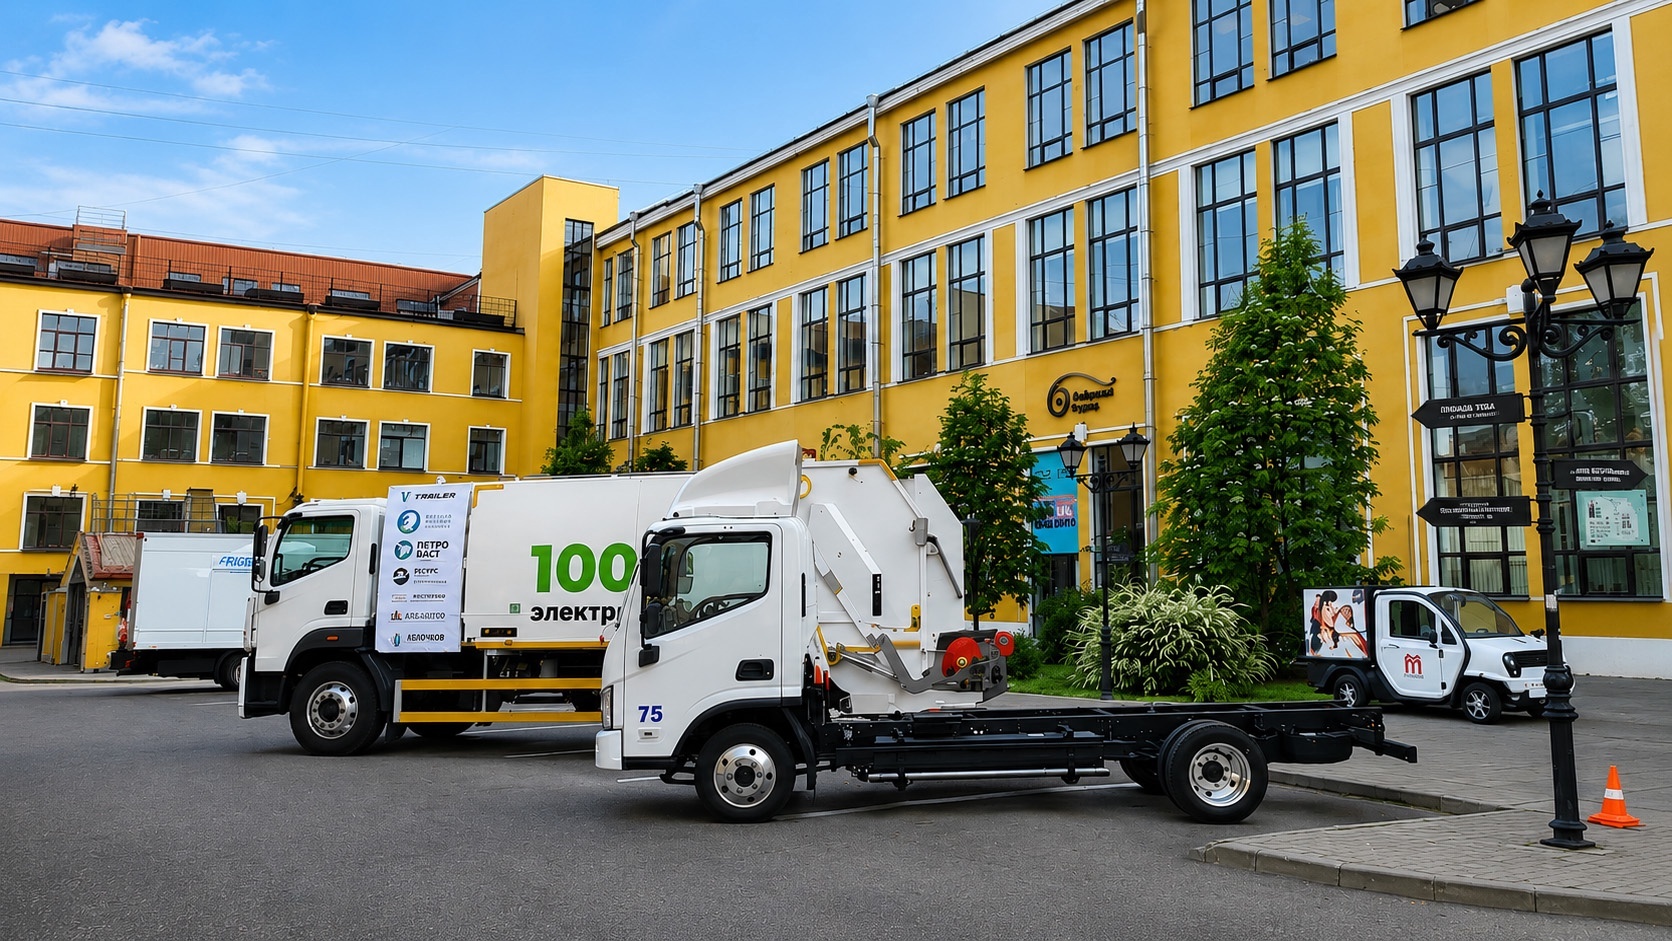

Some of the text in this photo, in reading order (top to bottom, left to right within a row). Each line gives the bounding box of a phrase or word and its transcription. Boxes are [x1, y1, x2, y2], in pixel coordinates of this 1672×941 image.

[415, 492, 456, 500] TRAILER
[416, 540, 449, 550] ПЕТРО
[530, 543, 638, 593] 100
[638, 705, 663, 723] 75
